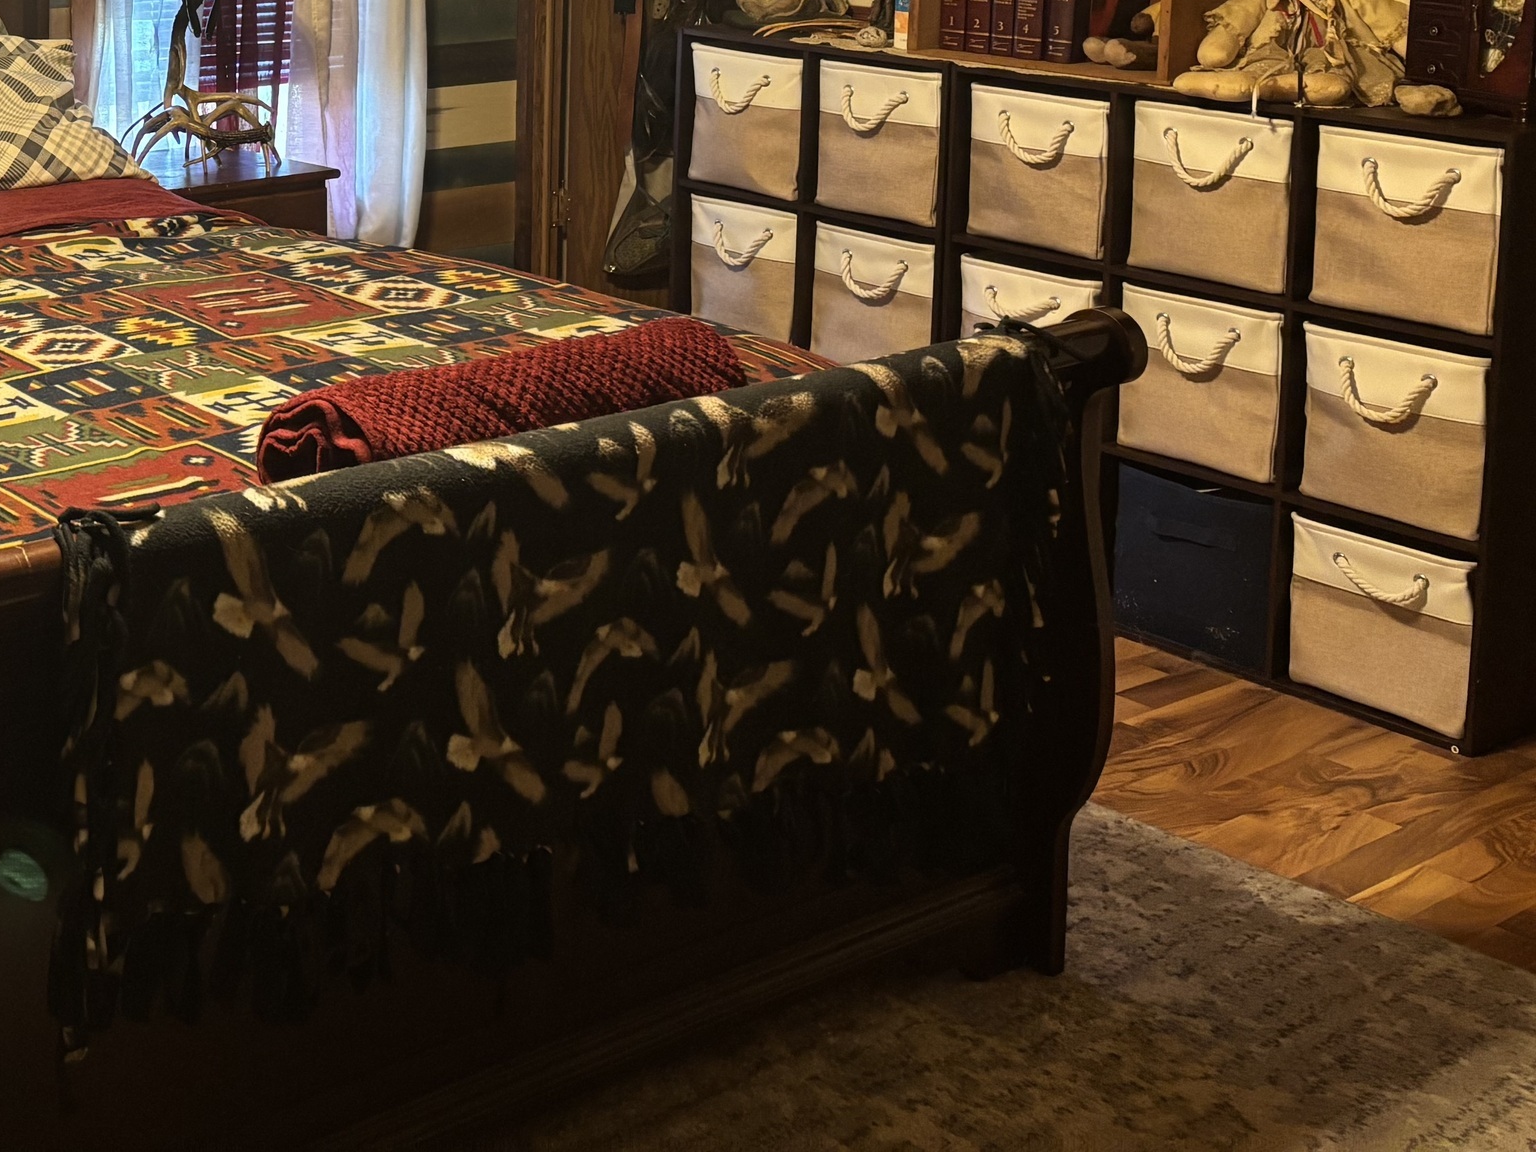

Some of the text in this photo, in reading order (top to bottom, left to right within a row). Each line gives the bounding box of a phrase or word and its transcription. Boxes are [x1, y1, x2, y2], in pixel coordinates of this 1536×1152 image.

[949, 16, 954, 26] 1
[973, 18, 980, 28] 2
[997, 21, 1004, 31] 3
[1022, 24, 1029, 34] 4
[1053, 26, 1059, 35] 5
